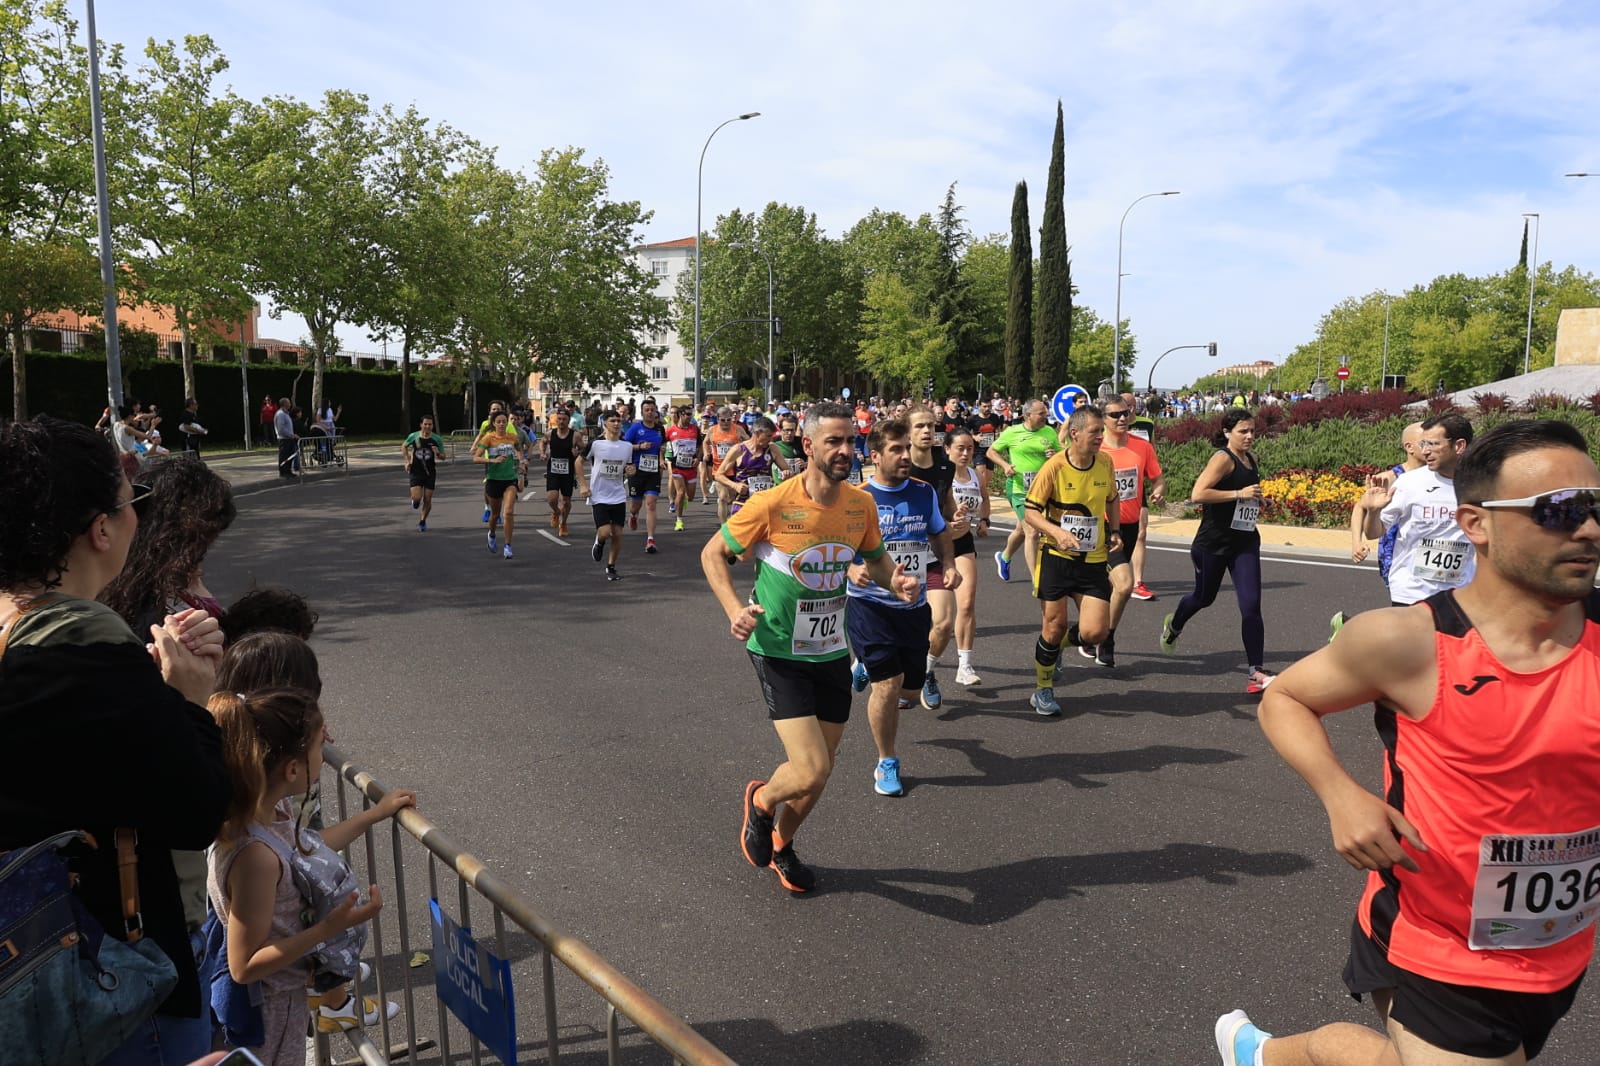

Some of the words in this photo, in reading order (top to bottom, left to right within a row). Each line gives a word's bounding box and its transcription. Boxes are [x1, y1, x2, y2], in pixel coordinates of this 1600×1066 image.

[606, 465, 618, 474] 194
[1423, 506, 1435, 519] El
[1423, 550, 1463, 570] 1405
[809, 613, 837, 638] 702
[1490, 838, 1524, 862] XII
[1529, 839, 1555, 851] SAN
[1496, 862, 1600, 914] 1036
[446, 955, 489, 1014] LOCAL
